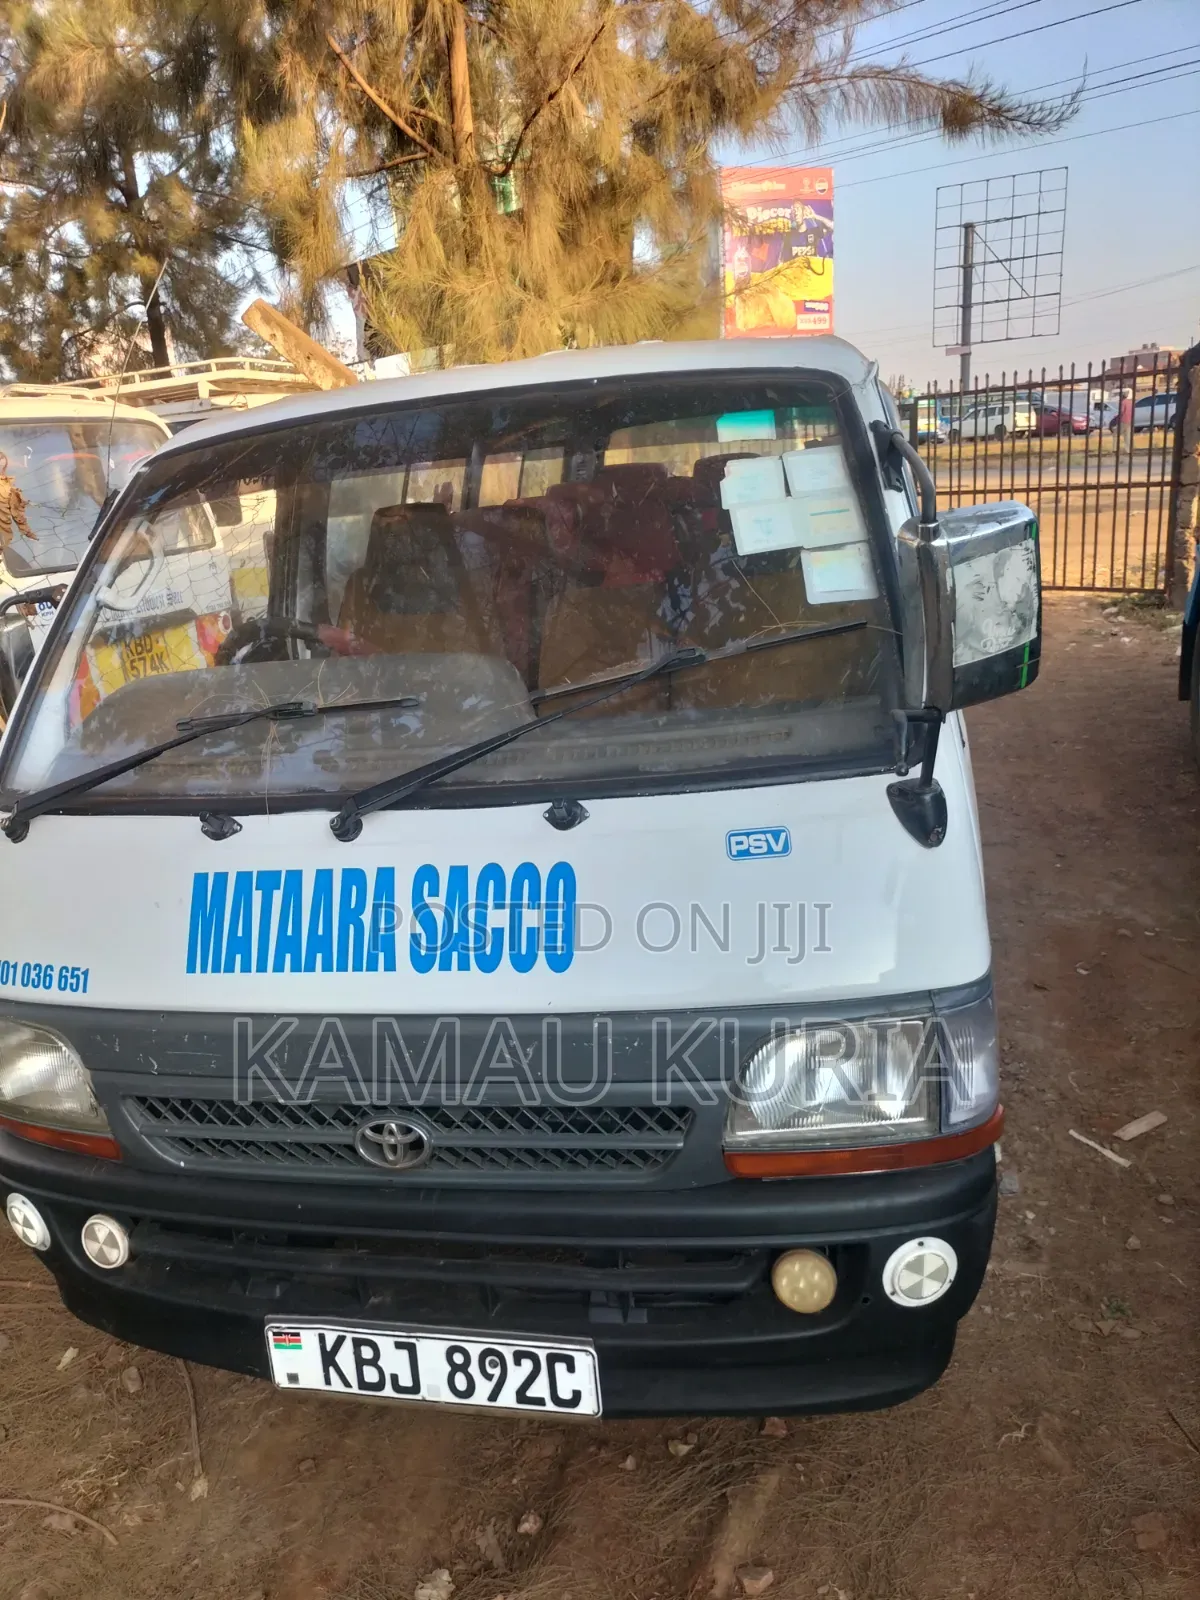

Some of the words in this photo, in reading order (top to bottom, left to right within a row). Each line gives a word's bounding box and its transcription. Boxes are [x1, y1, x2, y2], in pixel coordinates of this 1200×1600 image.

[129, 651, 169, 679] 574K
[729, 832, 787, 856] PSV
[186, 866, 396, 974] MATAARA
[409, 861, 577, 974] SACCO
[0, 960, 18, 986] 01
[21, 962, 54, 990] 036
[57, 965, 90, 994] 651
[317, 1332, 421, 1395] KBJ
[445, 1345, 582, 1409] 892C
